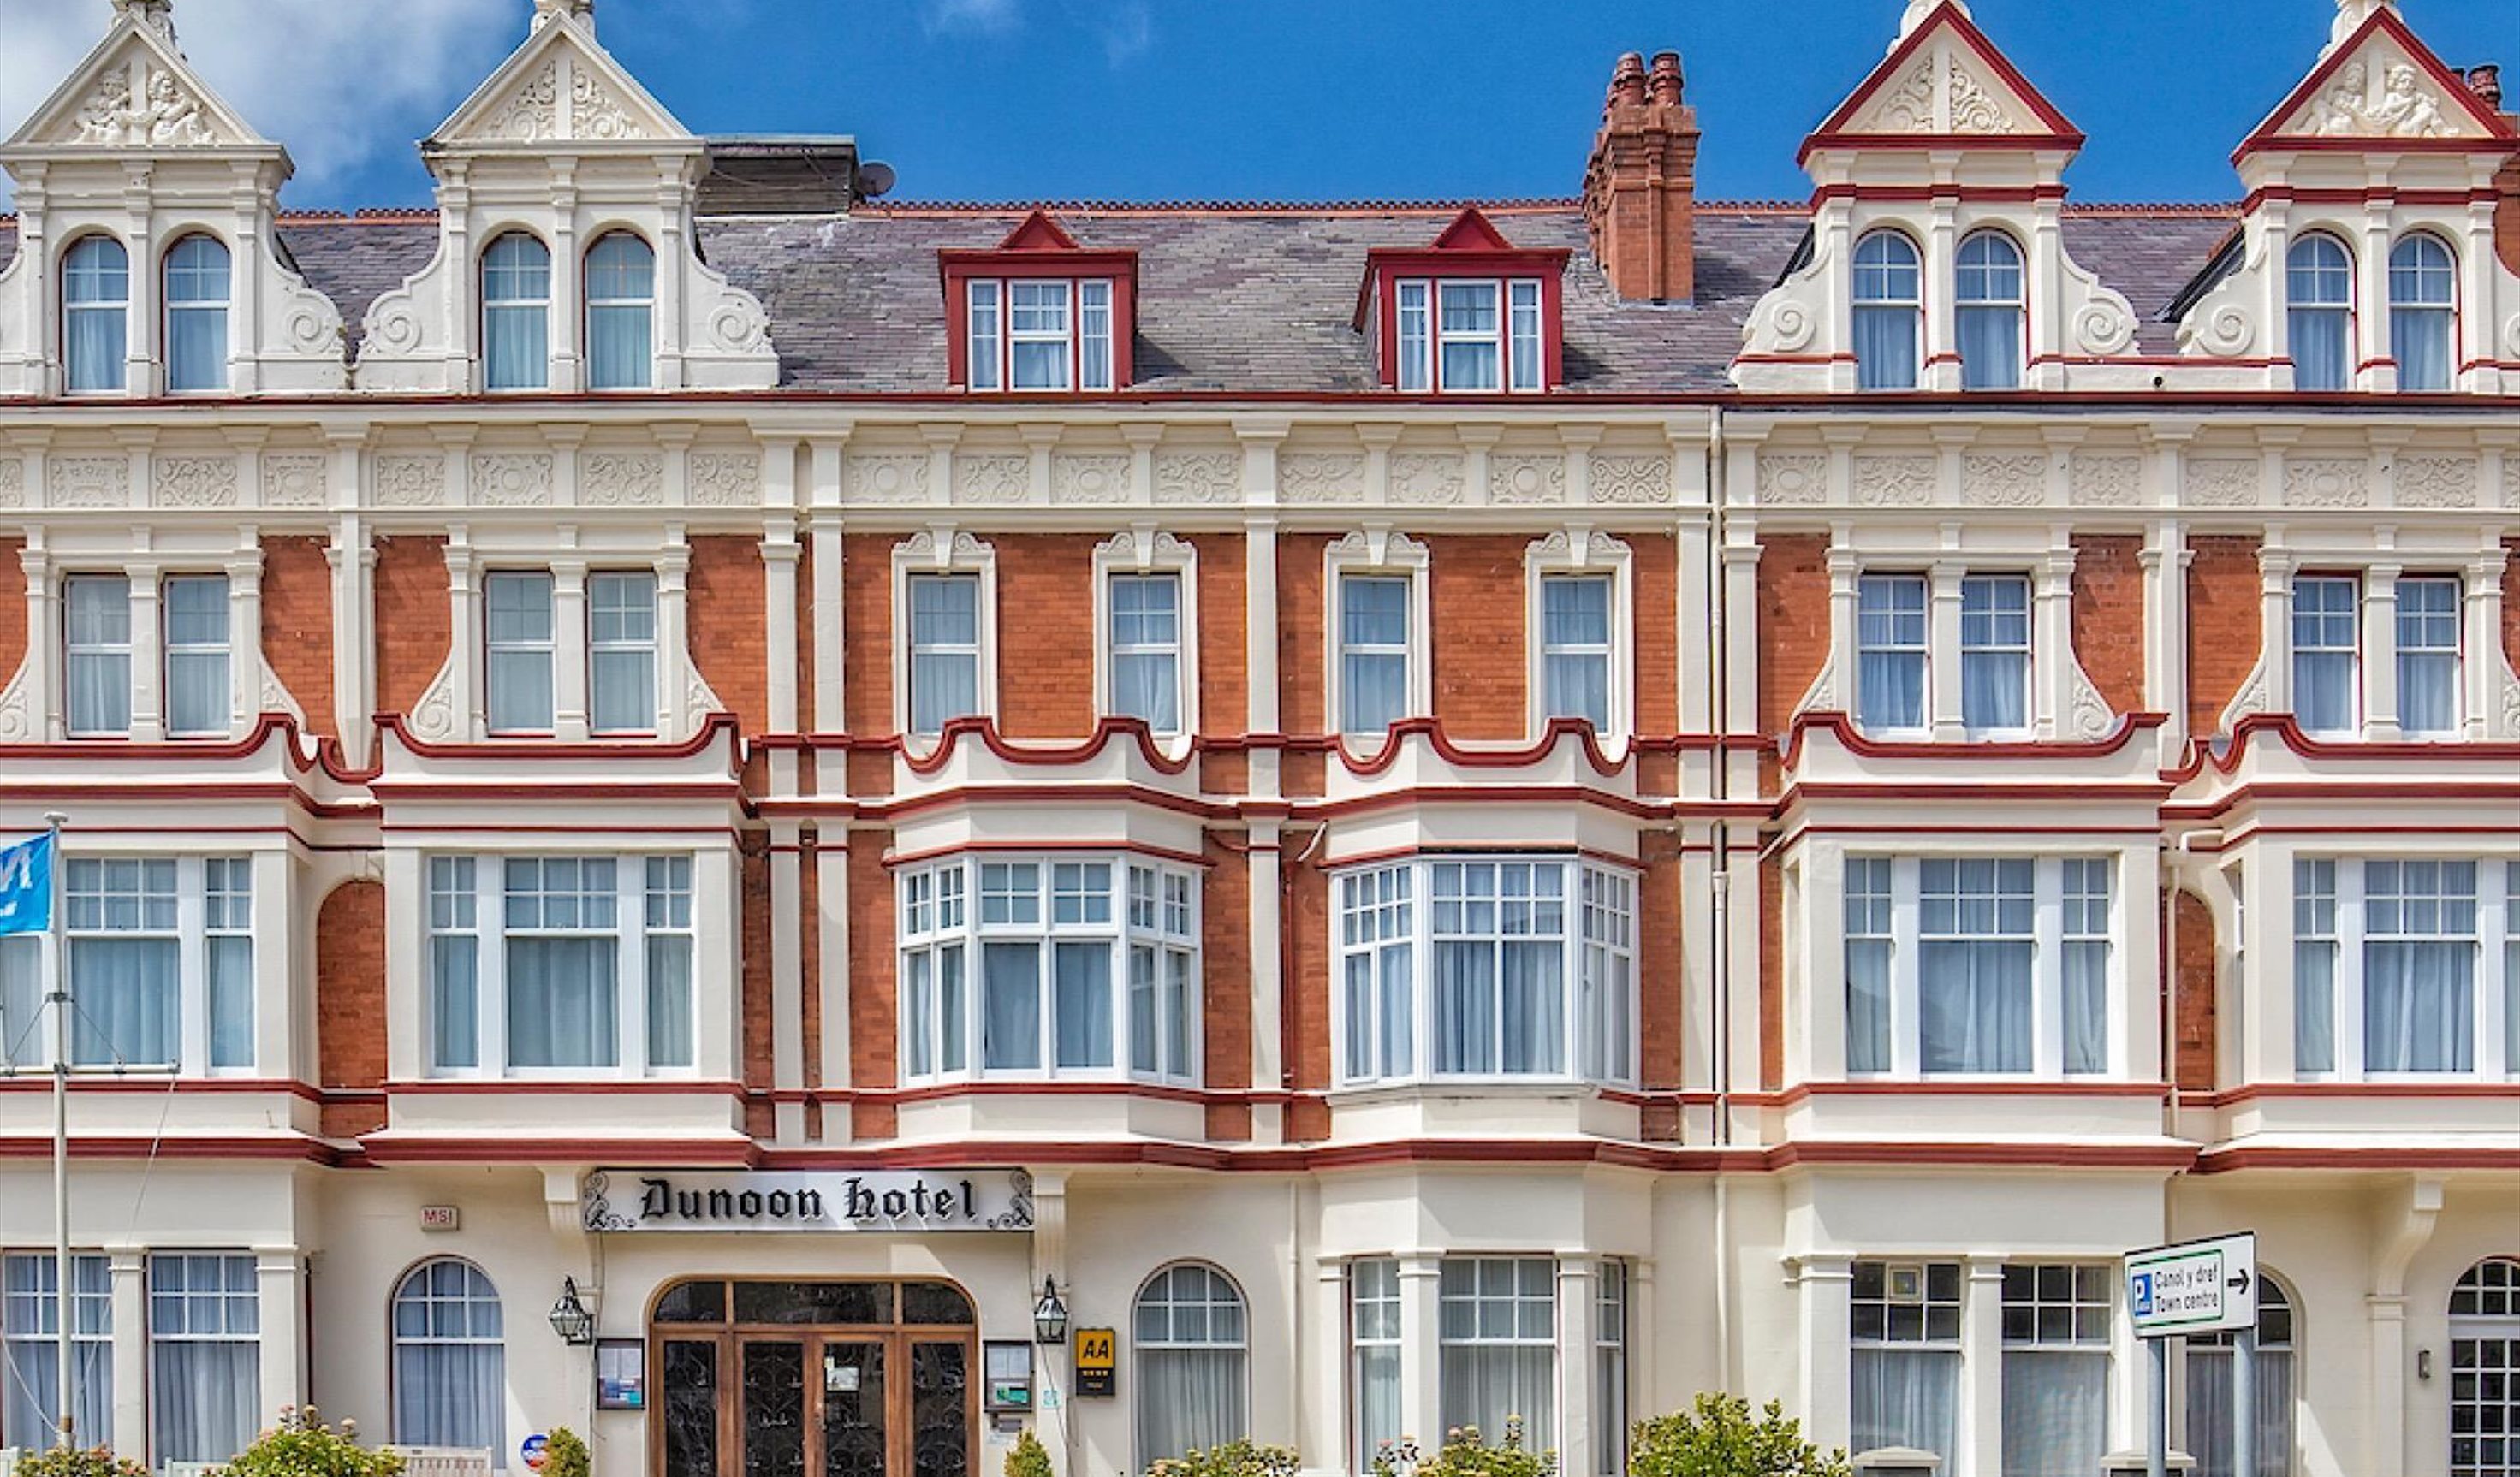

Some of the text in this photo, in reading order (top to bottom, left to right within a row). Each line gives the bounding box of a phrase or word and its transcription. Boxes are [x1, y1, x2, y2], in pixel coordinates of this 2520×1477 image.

[639, 1177, 823, 1219] Dunoon
[2154, 1295, 2183, 1313] Town
[2184, 1290, 2218, 1310] centre
[1082, 1339, 1109, 1360] AA
